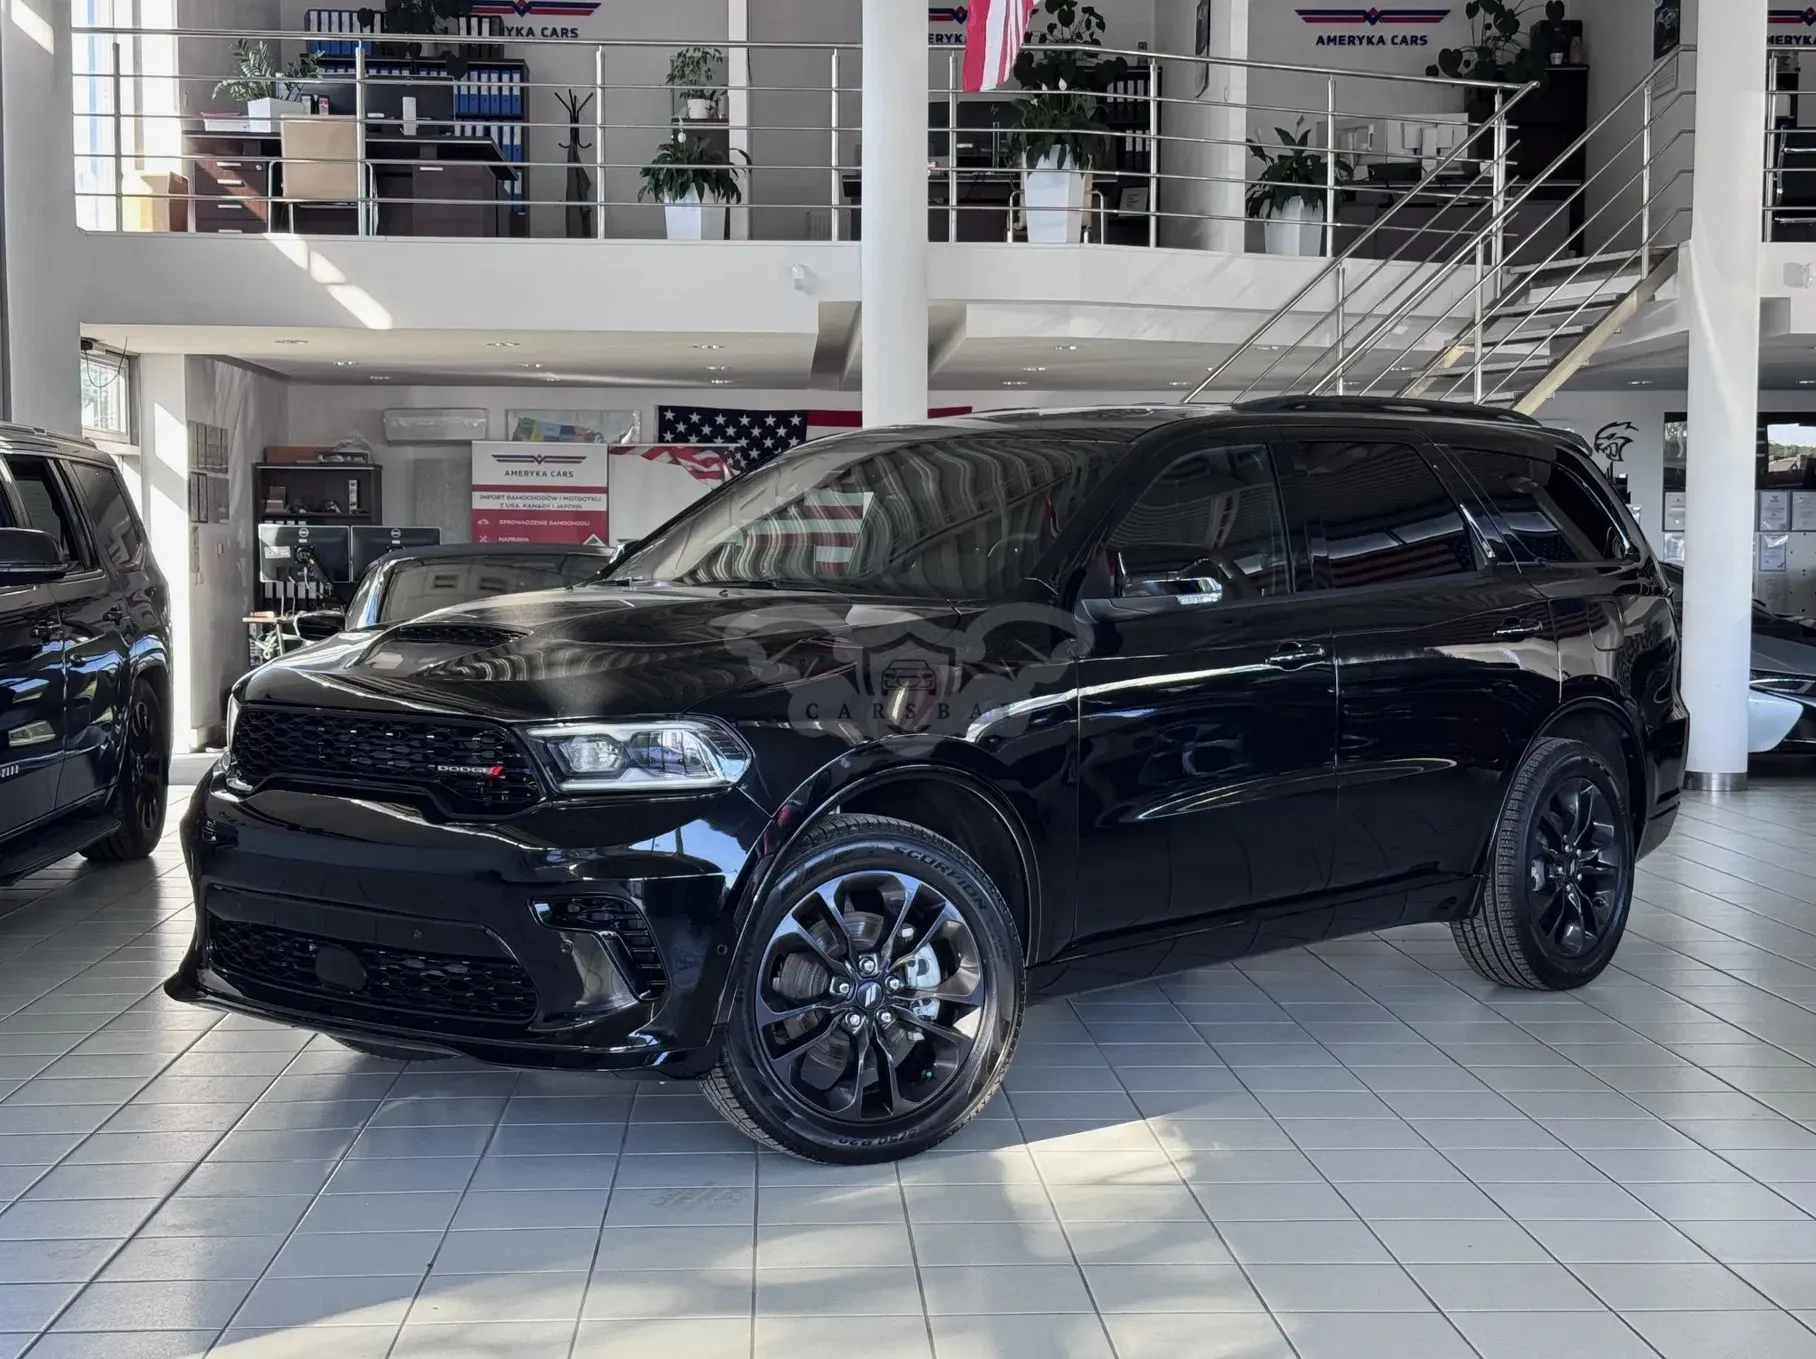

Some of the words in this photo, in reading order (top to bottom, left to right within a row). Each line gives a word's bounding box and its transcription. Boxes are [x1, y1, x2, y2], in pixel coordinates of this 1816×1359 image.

[505, 26, 535, 37] YKA
[541, 27, 579, 38] CARS
[928, 33, 966, 43] ERYK
[1316, 35, 1386, 46] AMERYKA
[1391, 35, 1428, 46] CARS
[504, 470, 548, 478] AMERYKA
[437, 765, 490, 774] DODGE
[894, 845, 988, 910] SCORPION
